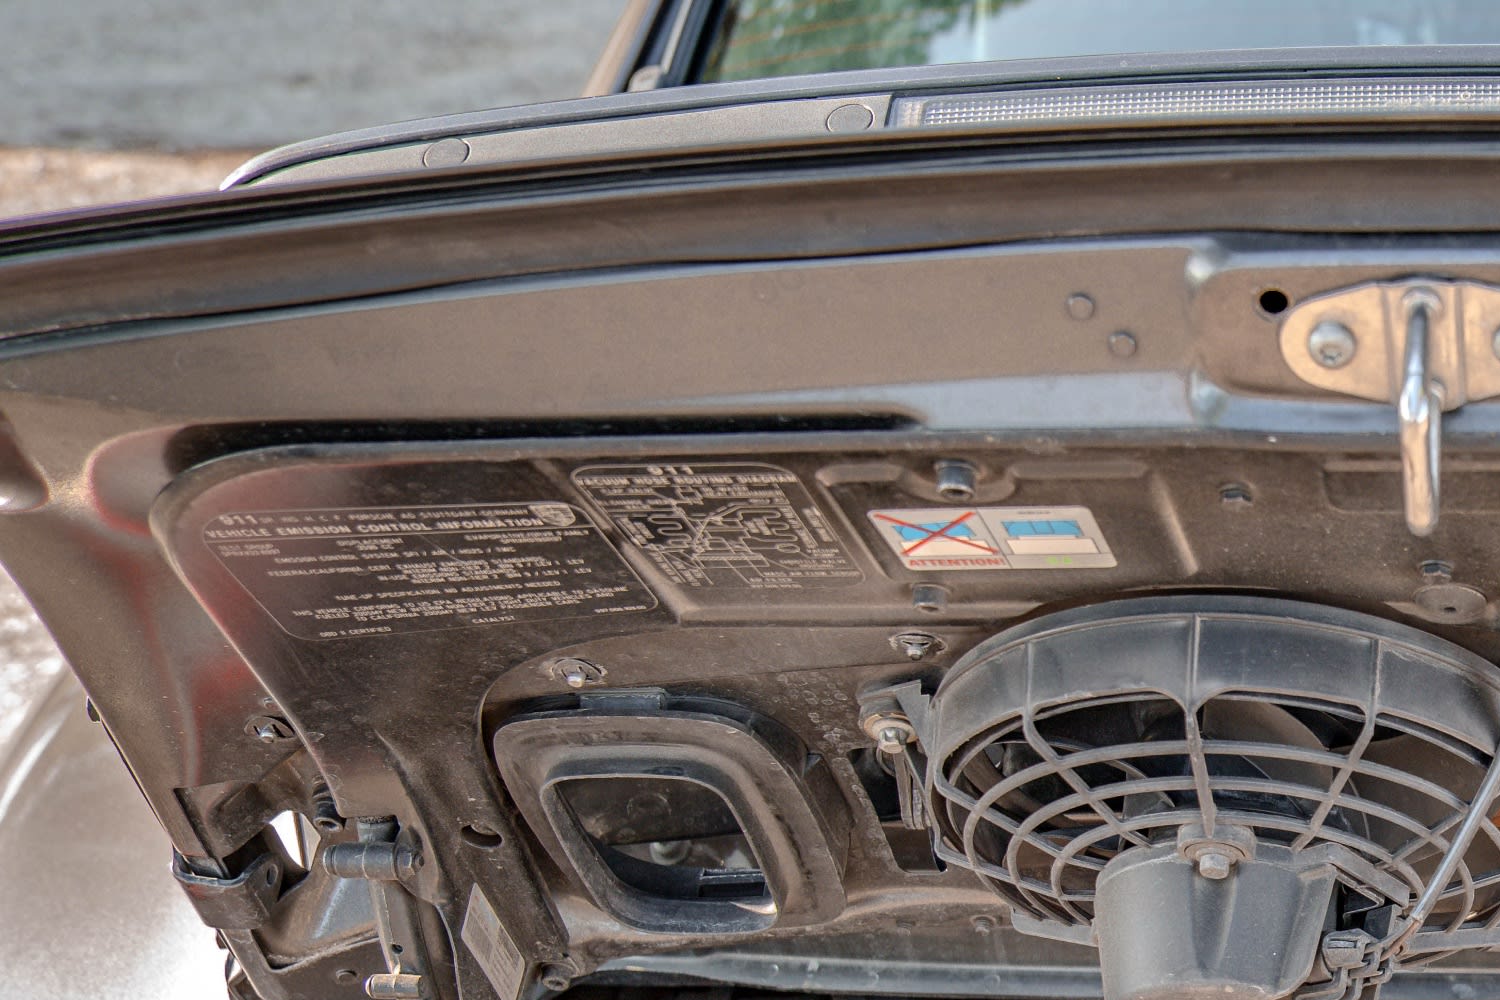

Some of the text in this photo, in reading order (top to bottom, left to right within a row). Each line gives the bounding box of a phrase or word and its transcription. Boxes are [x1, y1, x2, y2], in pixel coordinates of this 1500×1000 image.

[218, 515, 258, 525] 911
[205, 518, 544, 538] VEHICLE EMISSION CONTROL INFORMATION
